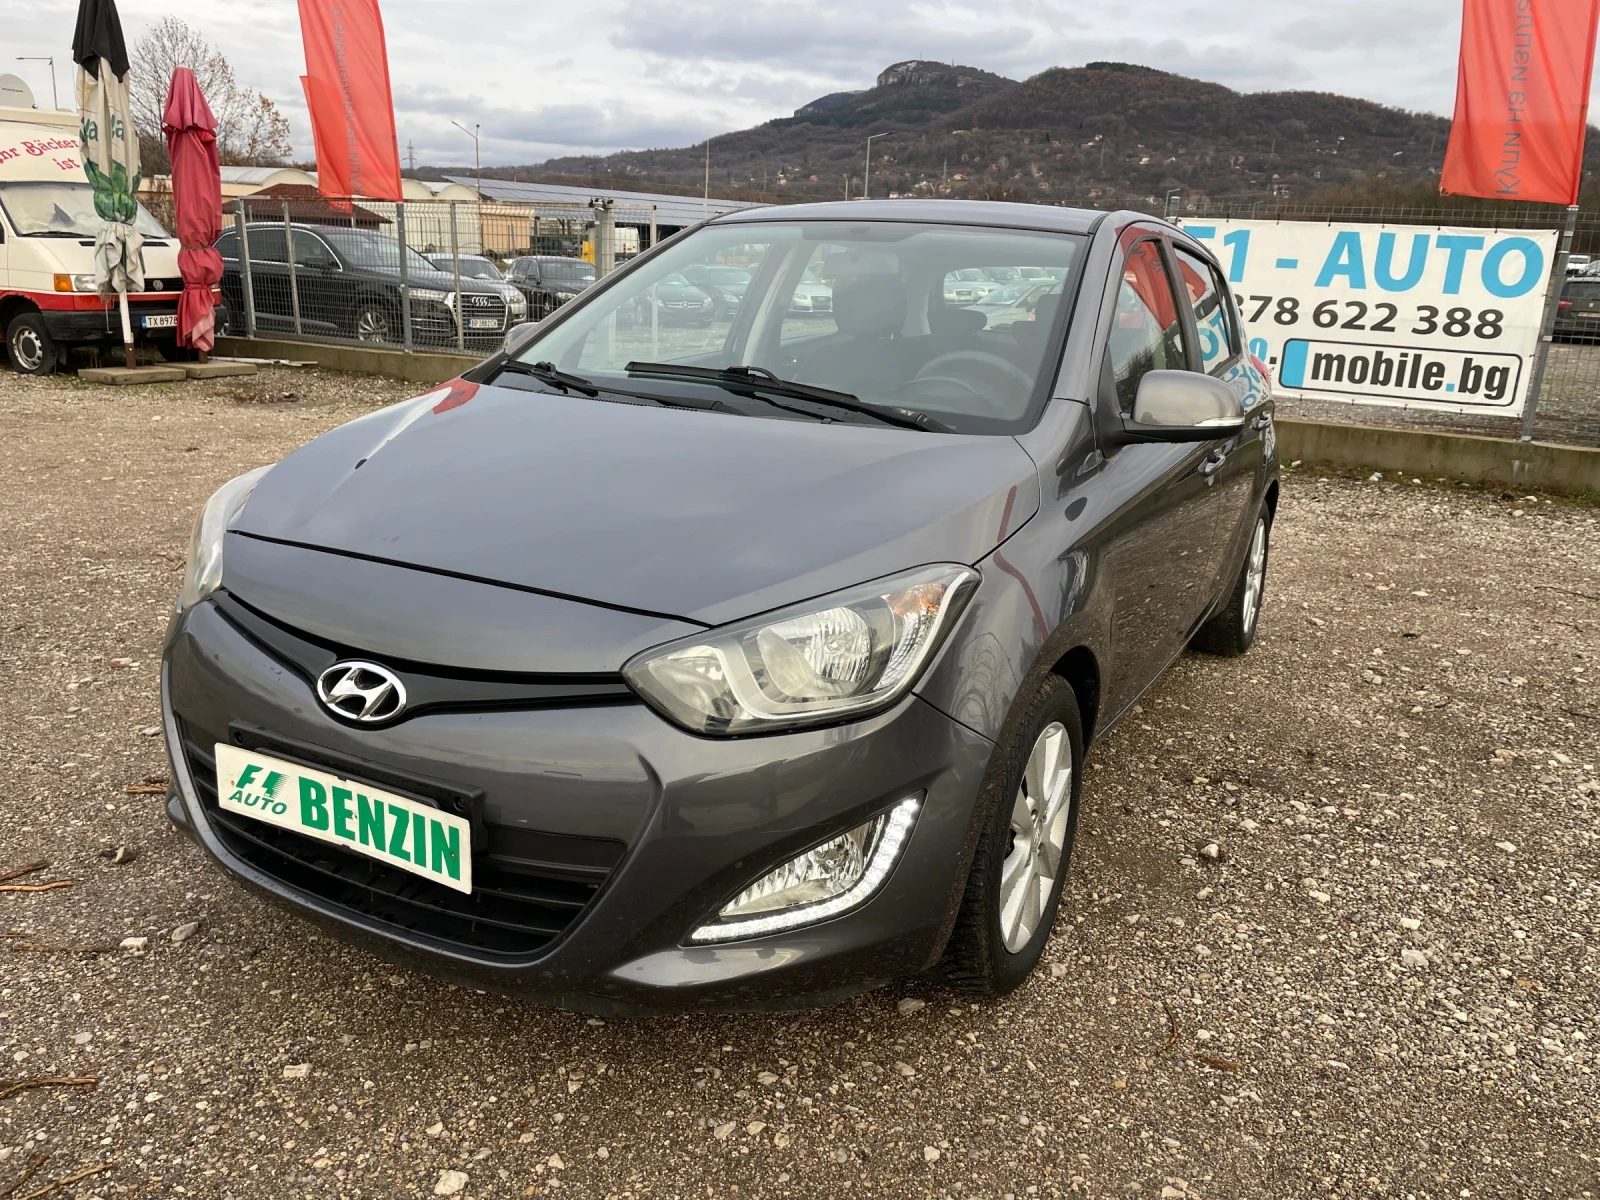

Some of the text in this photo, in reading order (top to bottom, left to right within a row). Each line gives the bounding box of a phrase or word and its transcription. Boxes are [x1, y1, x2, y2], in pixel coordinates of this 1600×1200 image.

[21, 138, 80, 156] Bäcker
[52, 157, 80, 170] ist
[1314, 231, 1544, 299] AUTO
[1312, 299, 1398, 332] 622
[1411, 304, 1504, 339] 388
[1311, 350, 1510, 400] mobile.bg
[228, 789, 287, 815] AUTO
[298, 776, 461, 881] BENZIN
